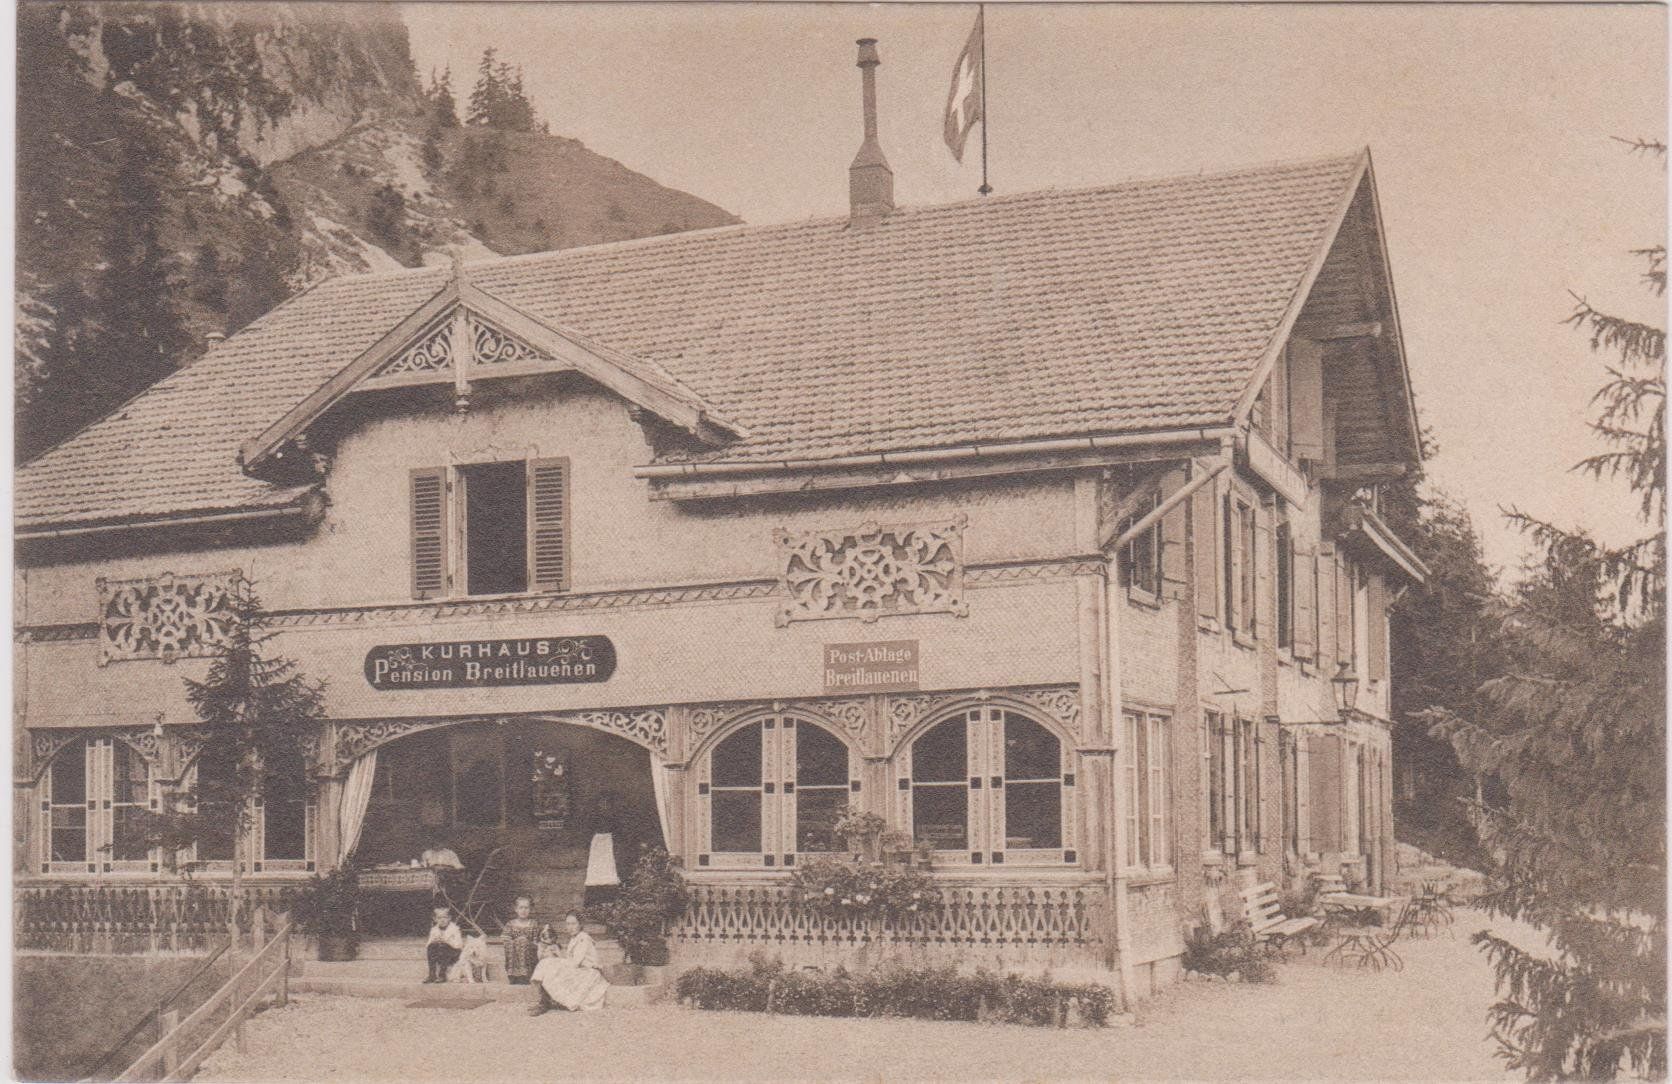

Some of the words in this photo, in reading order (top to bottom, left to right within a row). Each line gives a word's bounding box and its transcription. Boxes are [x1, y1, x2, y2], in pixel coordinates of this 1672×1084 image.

[422, 641, 550, 659] KURHAUS
[373, 659, 452, 684] Pension
[466, 660, 596, 681] Breitlauenen
[826, 668, 918, 687] Breitlauenen
